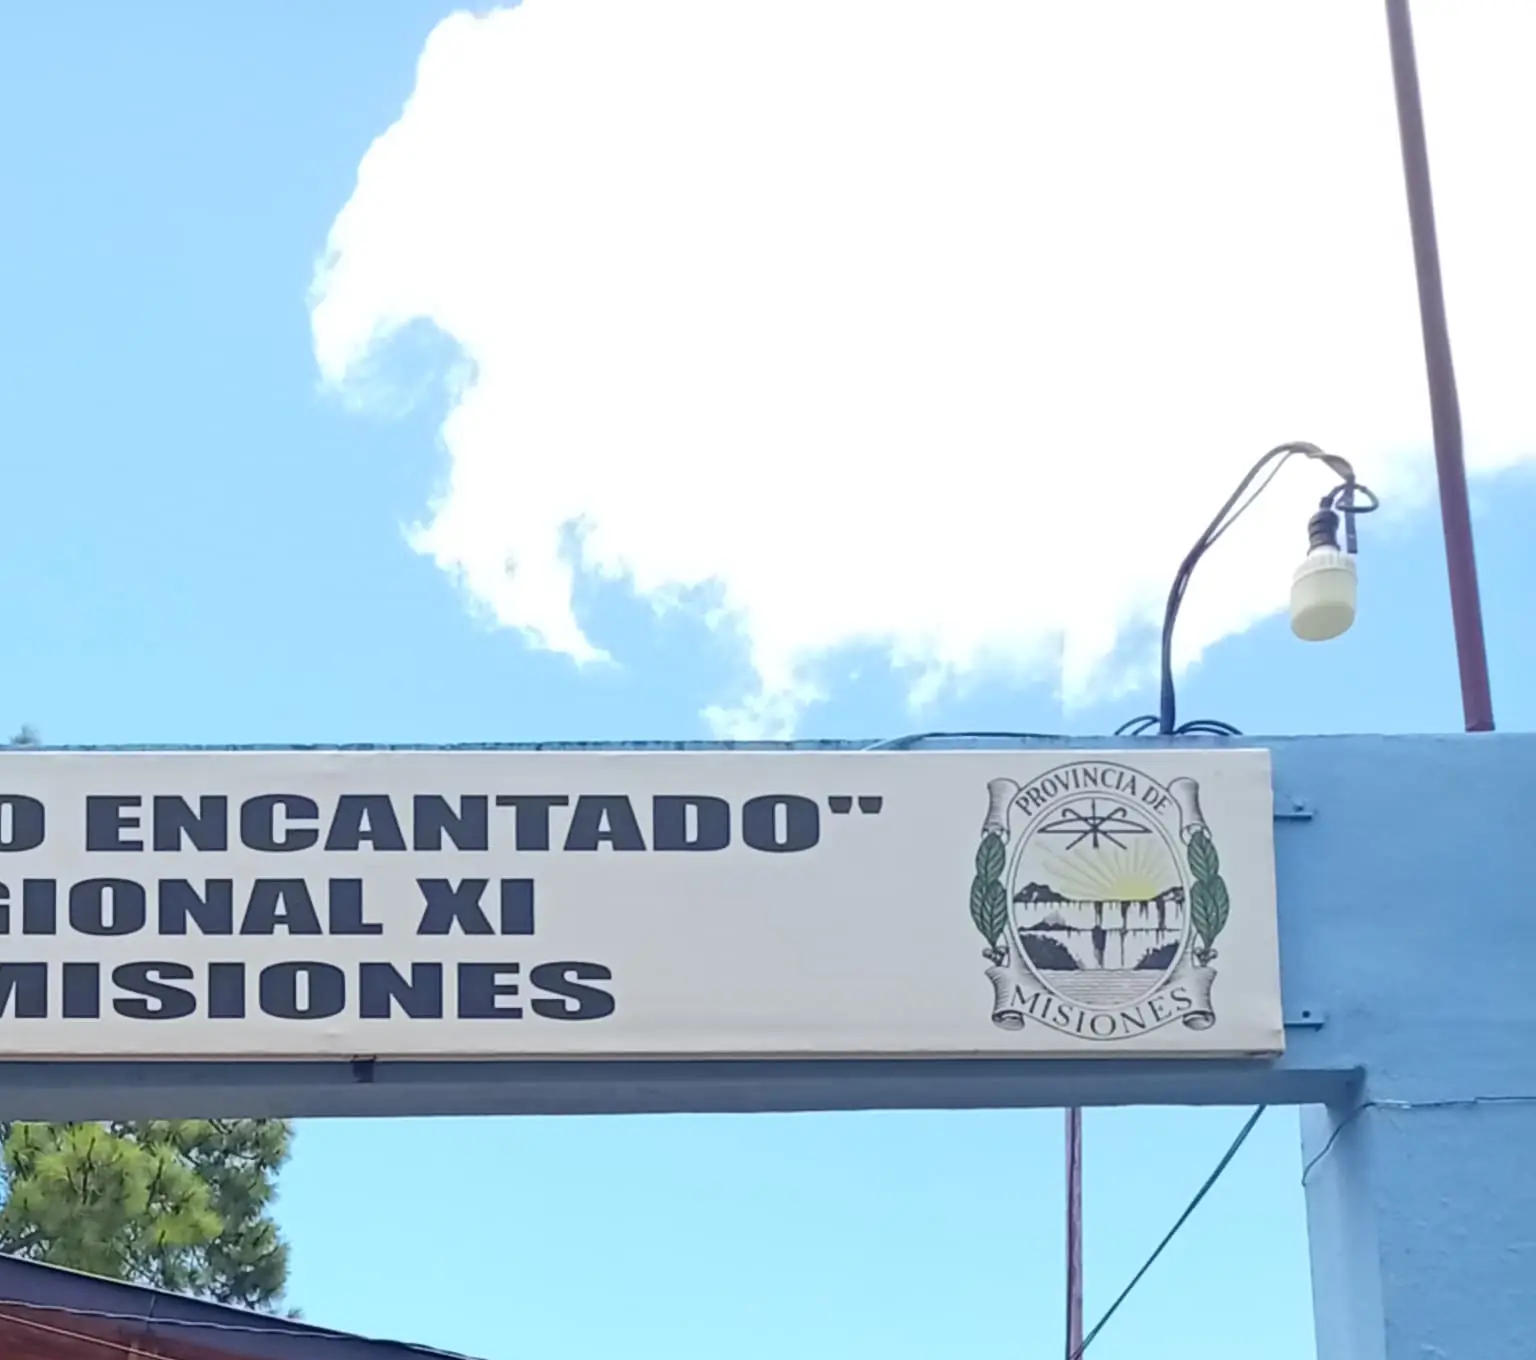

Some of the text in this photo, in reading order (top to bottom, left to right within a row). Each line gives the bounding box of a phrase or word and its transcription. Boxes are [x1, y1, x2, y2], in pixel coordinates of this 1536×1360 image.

[1015, 766, 1175, 816] PROVINCIA DE
[86, 794, 882, 853] ENCANTADO"
[417, 878, 534, 936] XI
[1010, 984, 1193, 1036] MISIONES
